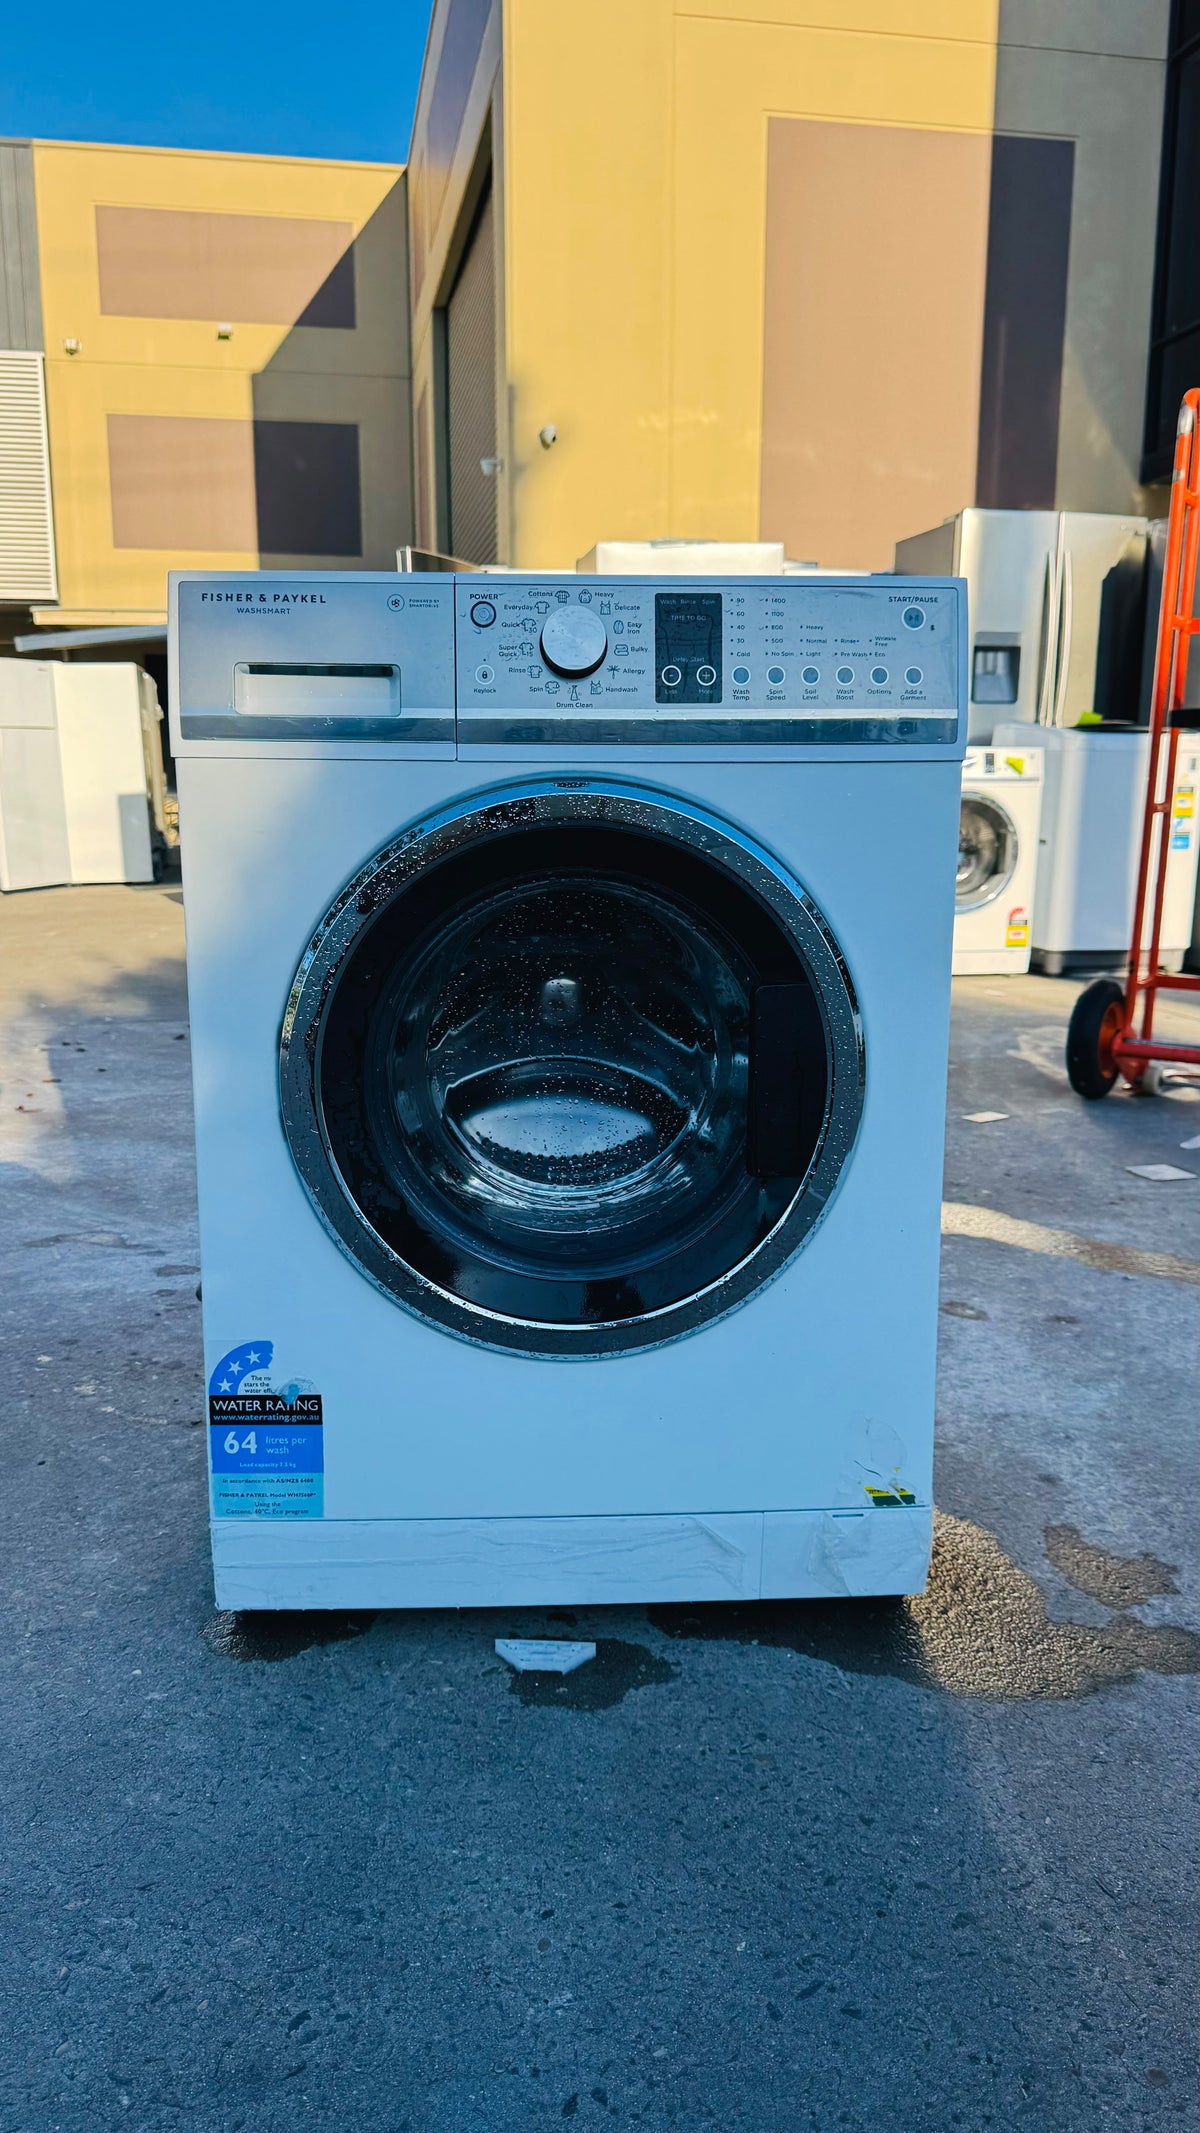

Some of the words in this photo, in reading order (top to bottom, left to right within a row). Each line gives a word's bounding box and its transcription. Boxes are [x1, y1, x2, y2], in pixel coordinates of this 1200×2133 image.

[201, 593, 253, 602] FISHER
[259, 593, 267, 602] &
[273, 594, 327, 604] PAYKEL
[888, 596, 939, 604] START/PAUSE
[237, 607, 291, 615] WASHSMART
[213, 1400, 261, 1412] WATER
[213, 1413, 320, 1423] www.waterrating.gov.au
[224, 1431, 258, 1454] 64
[266, 1435, 289, 1445] litres
[291, 1438, 307, 1447] per
[266, 1446, 289, 1454] wash
